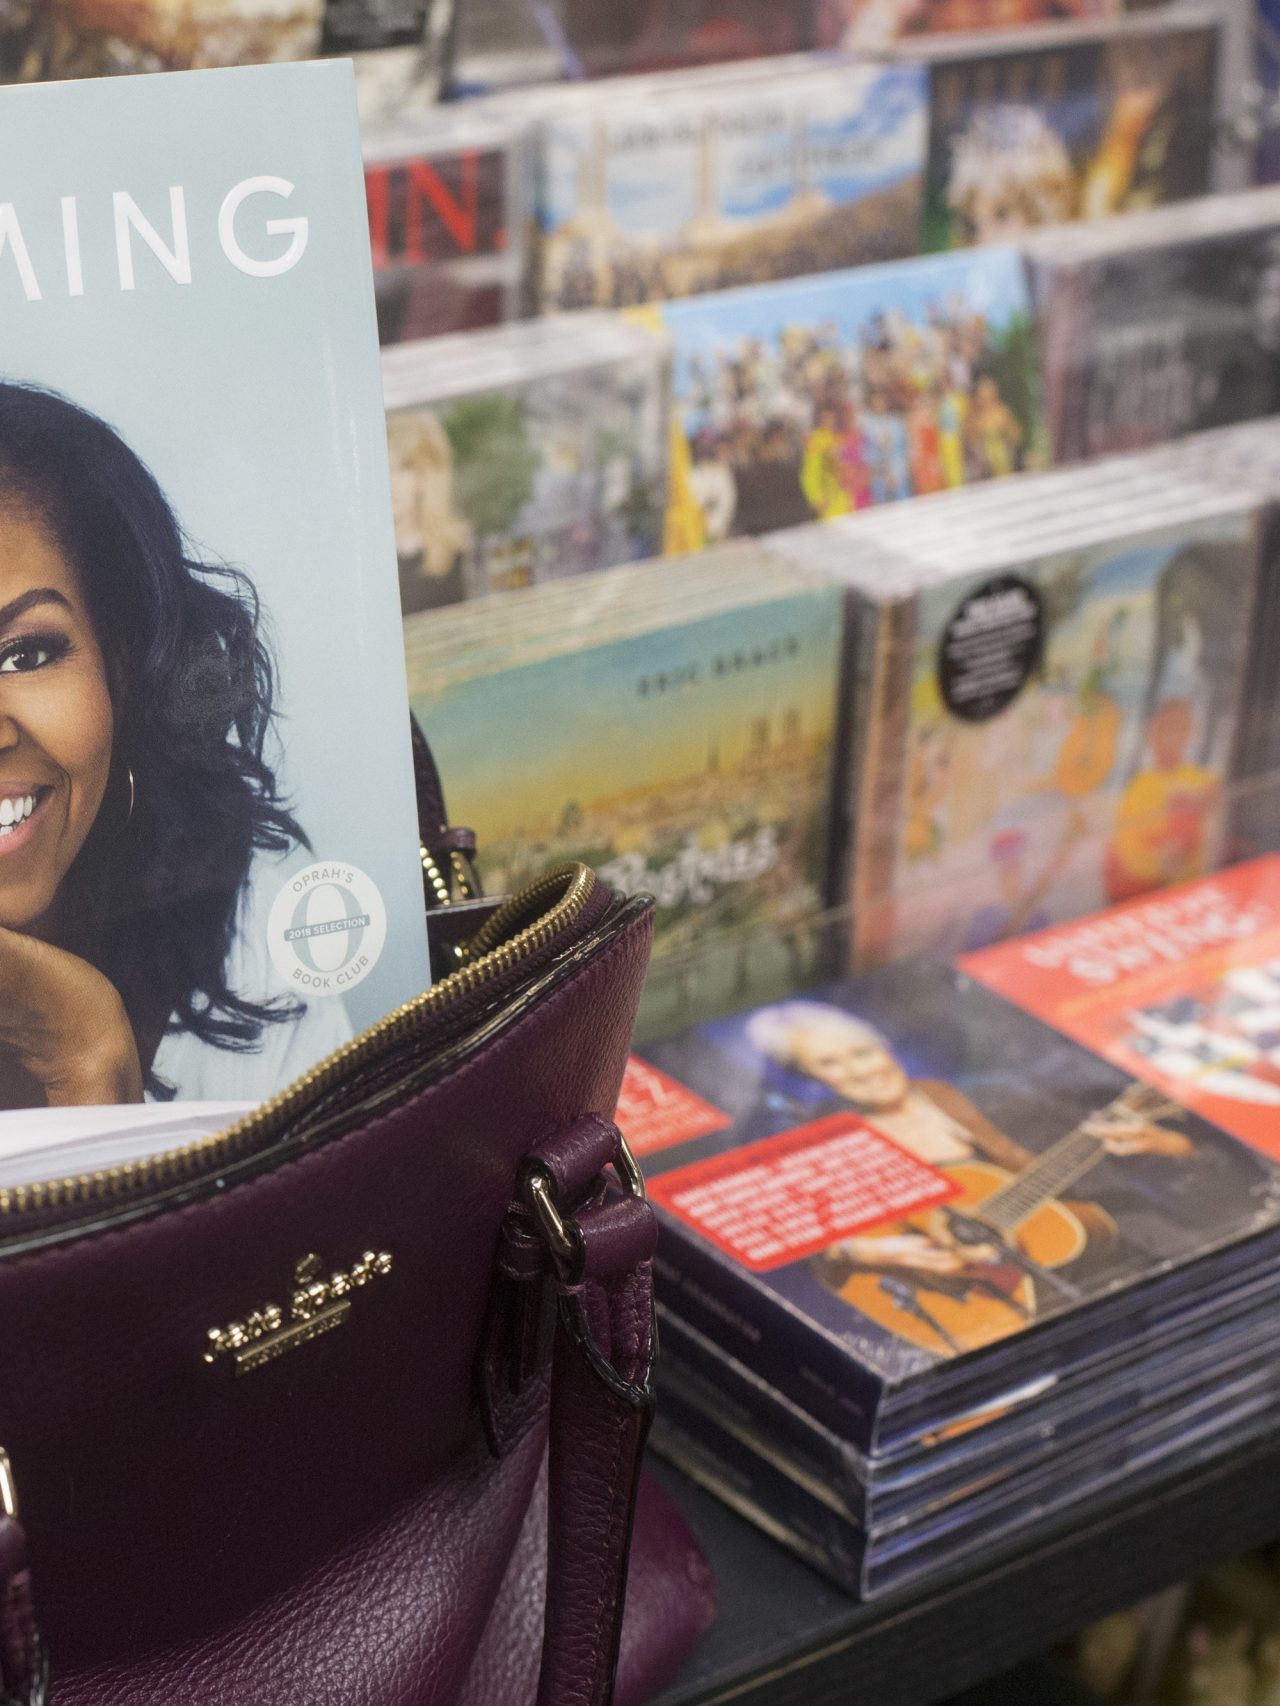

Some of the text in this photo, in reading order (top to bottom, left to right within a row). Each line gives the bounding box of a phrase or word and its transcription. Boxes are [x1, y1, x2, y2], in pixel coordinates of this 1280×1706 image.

[292, 868, 354, 892] OPRAH'S
[289, 917, 366, 939] 2018 SELECTION
[292, 956, 369, 988] BOOK CLUB
